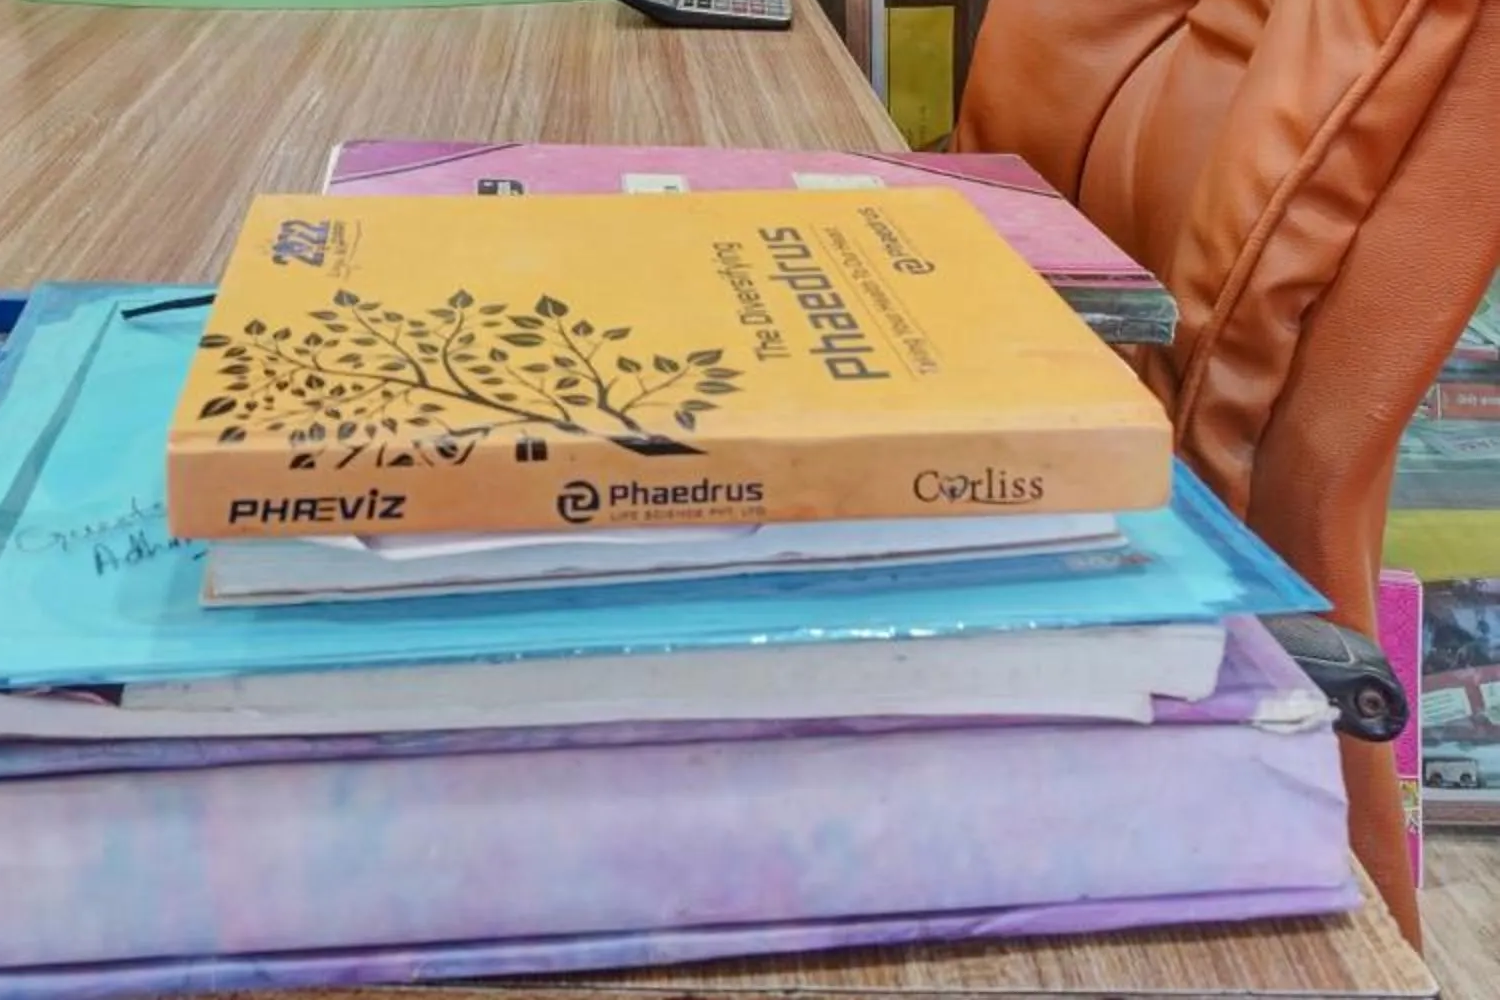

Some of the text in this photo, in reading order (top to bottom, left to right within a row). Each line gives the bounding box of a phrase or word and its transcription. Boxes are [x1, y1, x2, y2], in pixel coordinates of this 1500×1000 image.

[712, 241, 791, 361] The Diversifying
[758, 227, 891, 380] Phaedrus
[609, 478, 764, 507] Phaedrus
